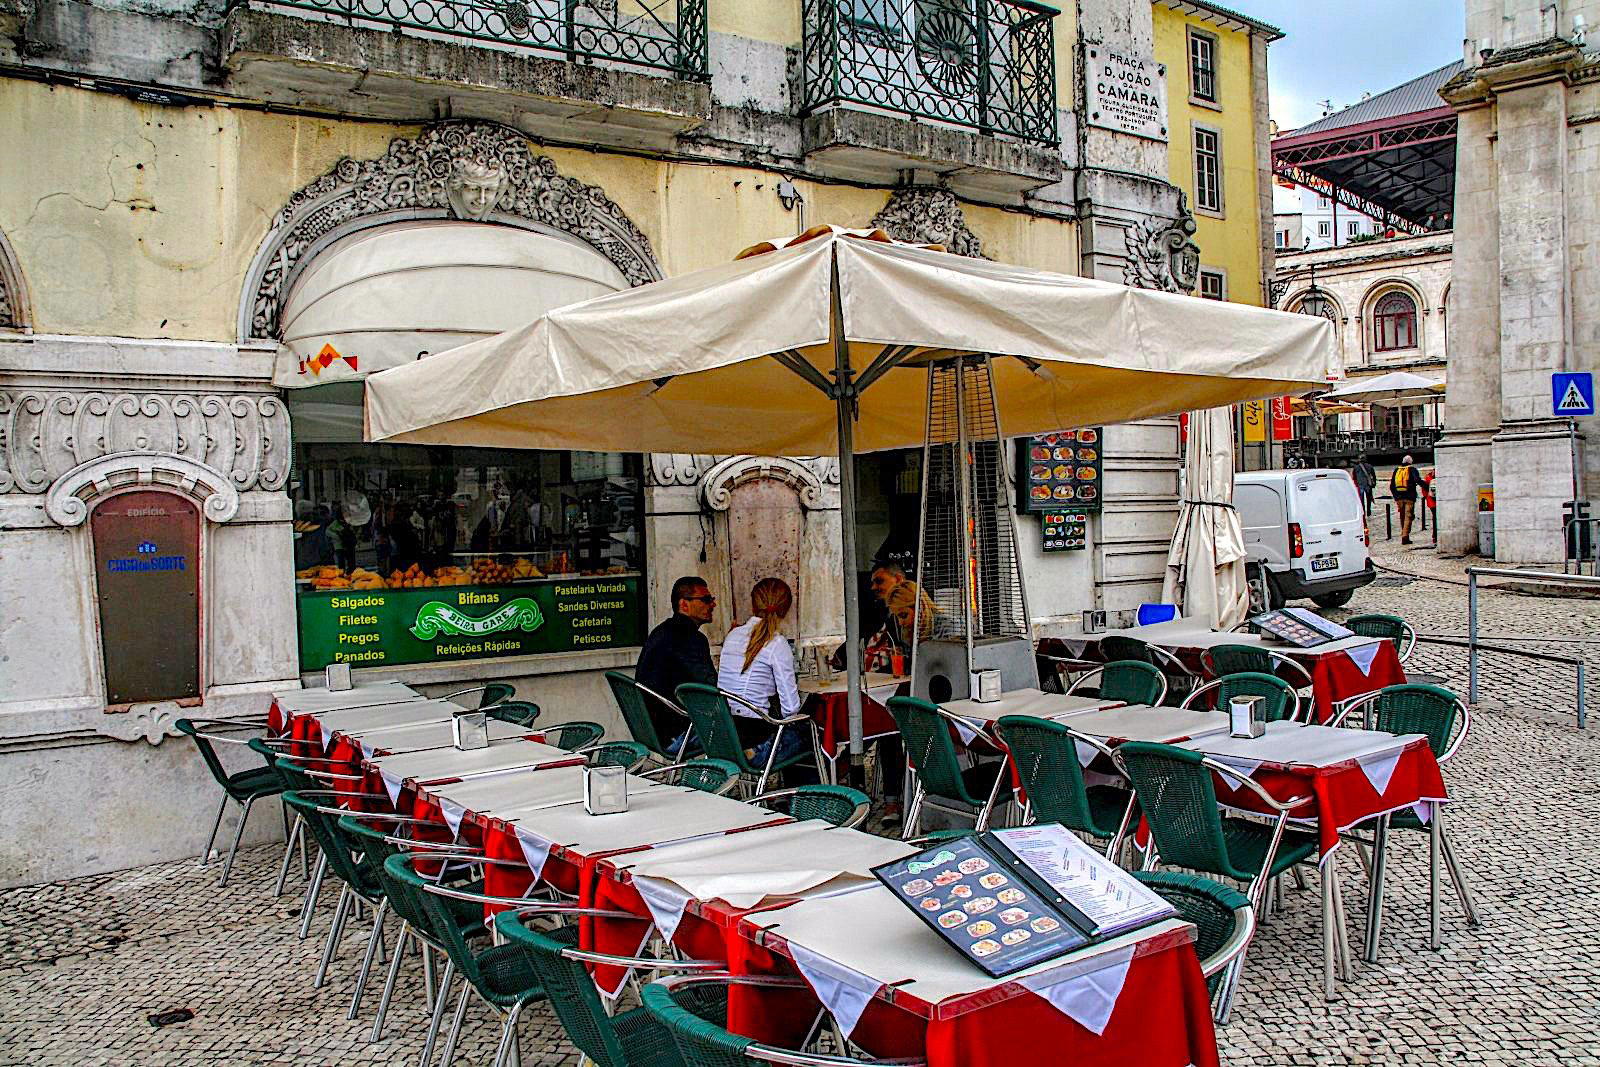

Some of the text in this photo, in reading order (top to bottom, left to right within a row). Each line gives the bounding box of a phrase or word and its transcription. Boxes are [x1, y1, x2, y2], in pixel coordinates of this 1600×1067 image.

[1110, 53, 1144, 70] PRAÇA
[1119, 71, 1151, 86] JOÃO
[1097, 83, 1159, 108] CAMARA
[1102, 105, 1123, 114] TEATRO
[127, 505, 166, 516] EDIFÍCIO
[151, 556, 185, 571] SORTE
[555, 583, 626, 595] Pastelaria Variada
[331, 596, 385, 610] Salgados
[458, 592, 499, 605] Bifanas
[558, 600, 625, 612] Sandes Diversas
[339, 615, 378, 626] Filetes
[448, 611, 510, 632] BEIRA GARE
[572, 616, 612, 627] Cafetaria
[339, 633, 380, 645] Pregos
[573, 634, 612, 644] Petiscos
[436, 640, 521, 656] Refeições Rápidas
[335, 650, 385, 662] Panados
